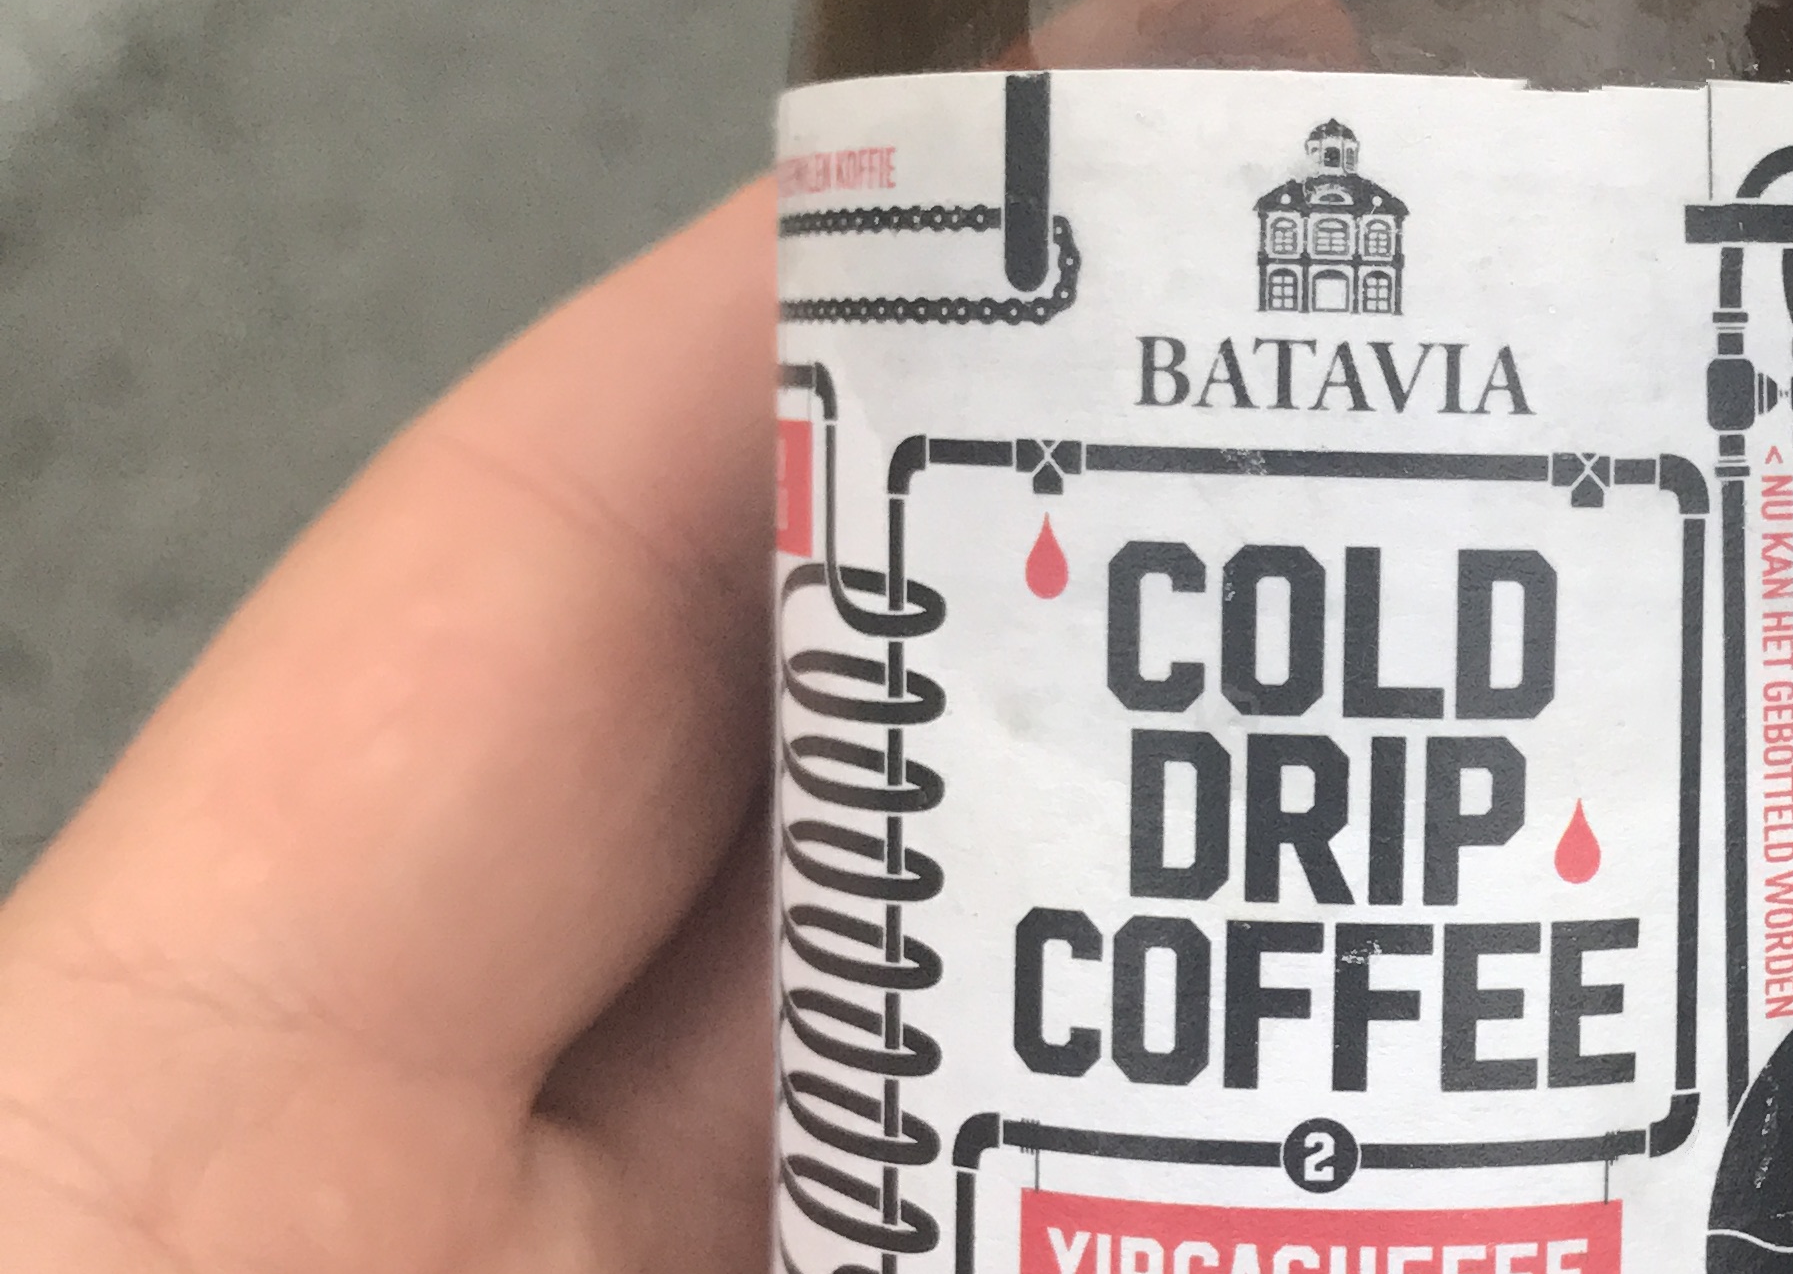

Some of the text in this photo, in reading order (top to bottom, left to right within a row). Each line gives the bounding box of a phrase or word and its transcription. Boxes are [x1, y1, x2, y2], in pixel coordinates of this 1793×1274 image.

[1135, 335, 1536, 415] BATAVIA
[1760, 474, 1793, 521] NU
[1107, 541, 1557, 721] COLD
[1130, 729, 1527, 906] DRIP
[1013, 907, 1639, 1093] COFFEE
[1303, 1132, 1335, 1182] 2
